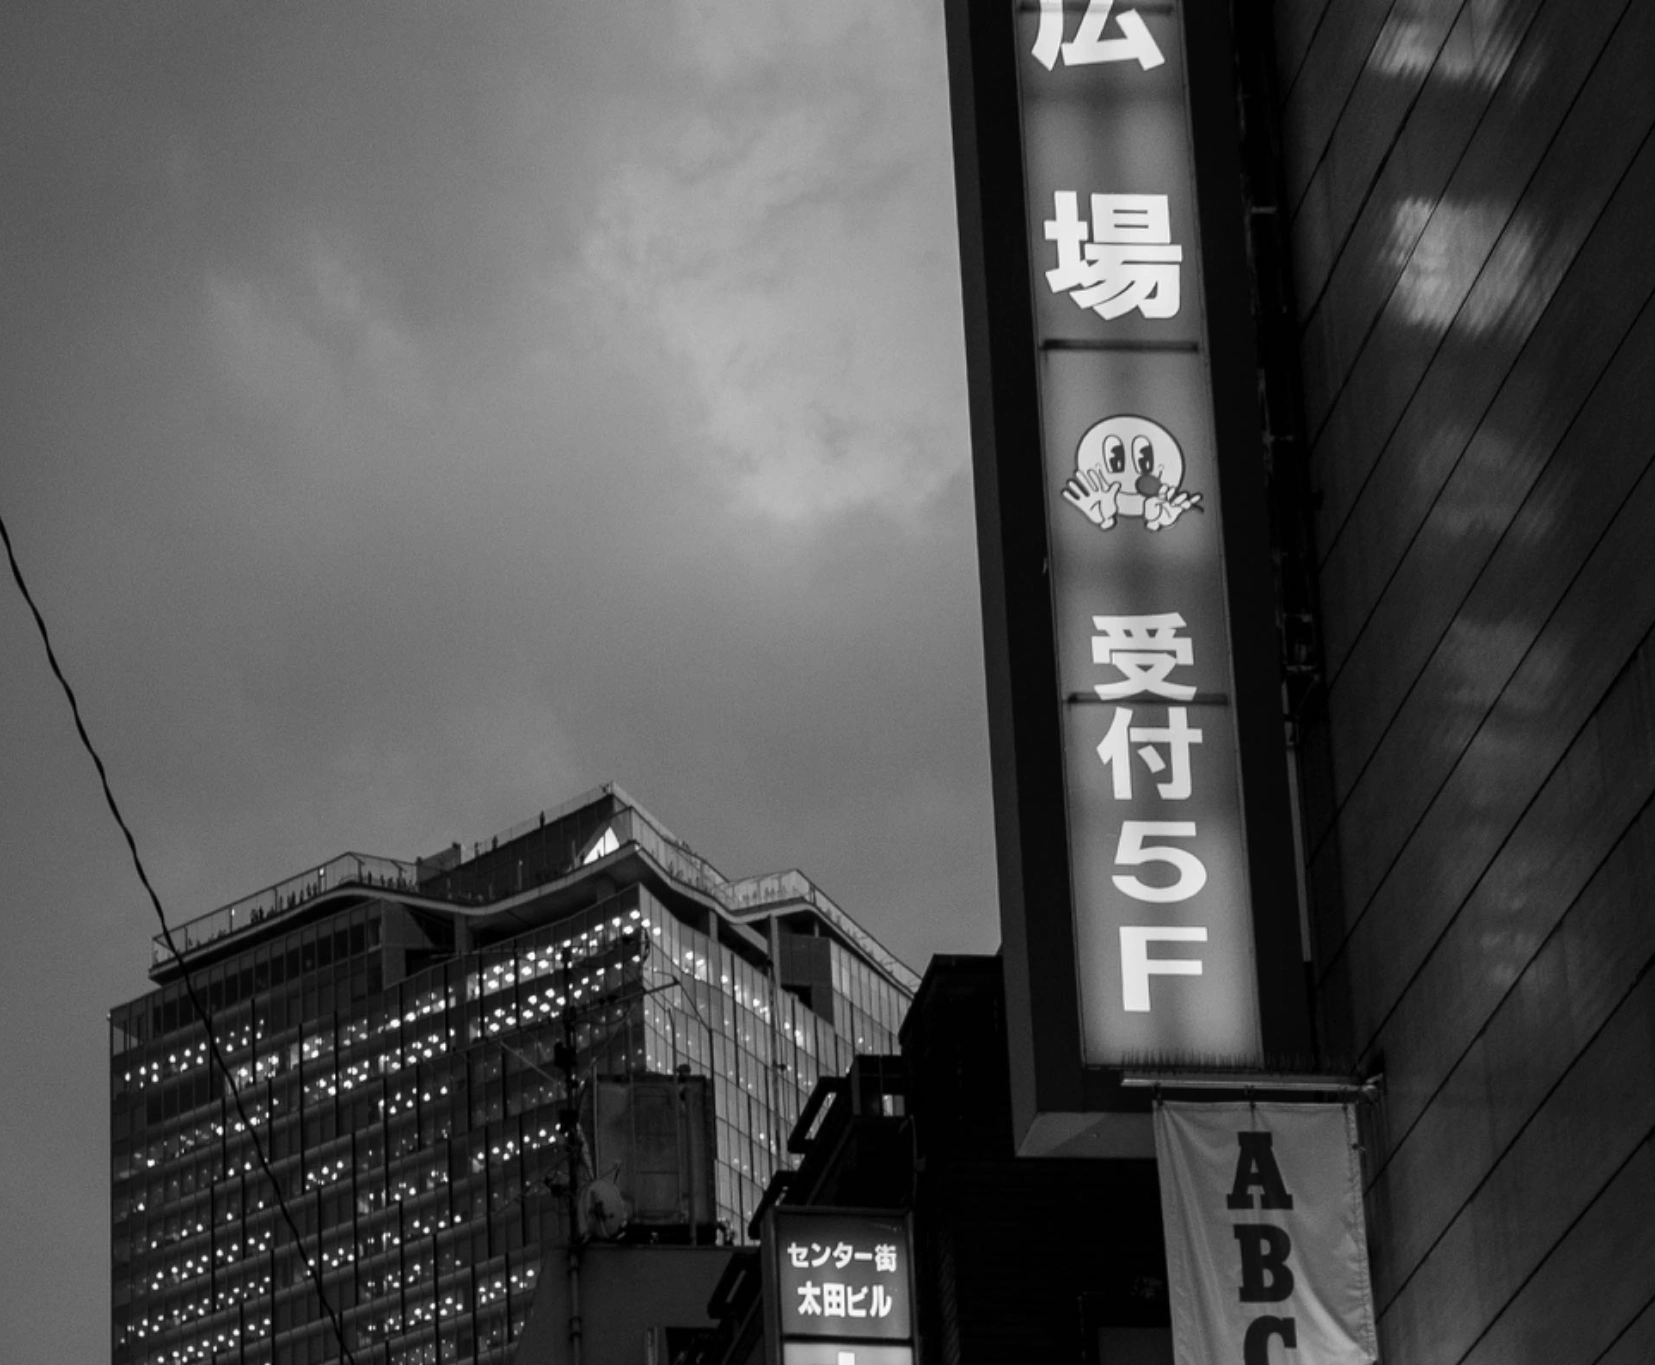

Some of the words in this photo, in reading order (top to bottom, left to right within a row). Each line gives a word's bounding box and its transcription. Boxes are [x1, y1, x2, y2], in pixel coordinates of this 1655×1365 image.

[1090, 612, 1208, 1012] 受付5F
[787, 1242, 897, 1273] センター街
[798, 1282, 893, 1320] 太田ビル
